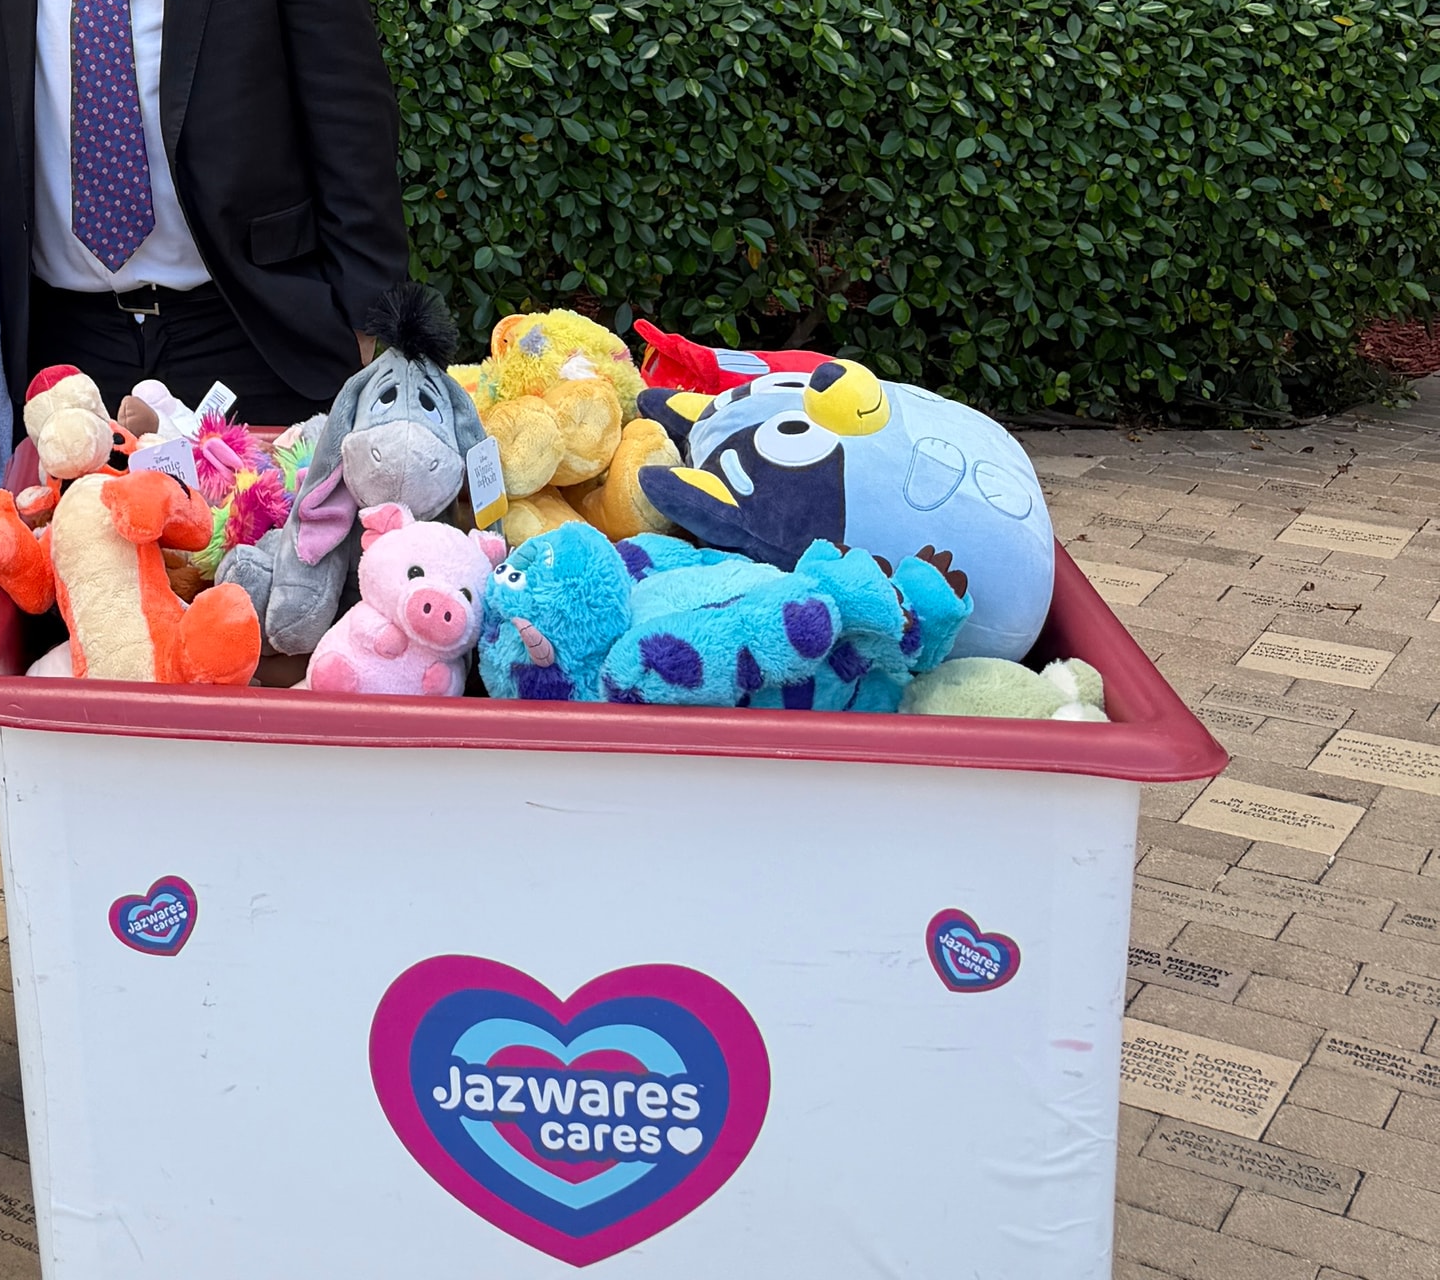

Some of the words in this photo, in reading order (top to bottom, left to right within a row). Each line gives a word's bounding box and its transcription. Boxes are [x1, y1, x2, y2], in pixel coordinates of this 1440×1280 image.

[1229, 797, 1244, 805] IN
[1248, 801, 1298, 816] HONOR
[1302, 812, 1322, 821] OF
[1248, 806, 1277, 817] AND
[128, 901, 184, 935] Jazwares
[153, 914, 180, 932] cares
[939, 933, 1001, 973] Jazwares
[958, 955, 987, 977] cares
[1166, 955, 1233, 978] MEMORY
[1162, 969, 1221, 988] 1/28/24
[1167, 963, 1219, 981] DUTRA
[1365, 984, 1407, 1000] LOVE
[1134, 1036, 1190, 1057] SOUTH
[1195, 1052, 1264, 1077] FLORIDA
[1326, 1044, 1407, 1073] SURGICAL
[1329, 1038, 1417, 1067] MEMORIAL
[1183, 1065, 1215, 1079] YOU
[1220, 1076, 1271, 1094] MUCH
[1183, 1074, 1221, 1089] WITH
[1228, 1086, 1270, 1102] YOUR
[1192, 1060, 1280, 1088] HOMECARE
[432, 1065, 701, 1121] Jazwares
[1143, 1079, 1187, 1096] LOVE
[1210, 1097, 1260, 1116] HUGS
[1192, 1084, 1265, 1110] HOSPITAL
[540, 1121, 662, 1154] cares
